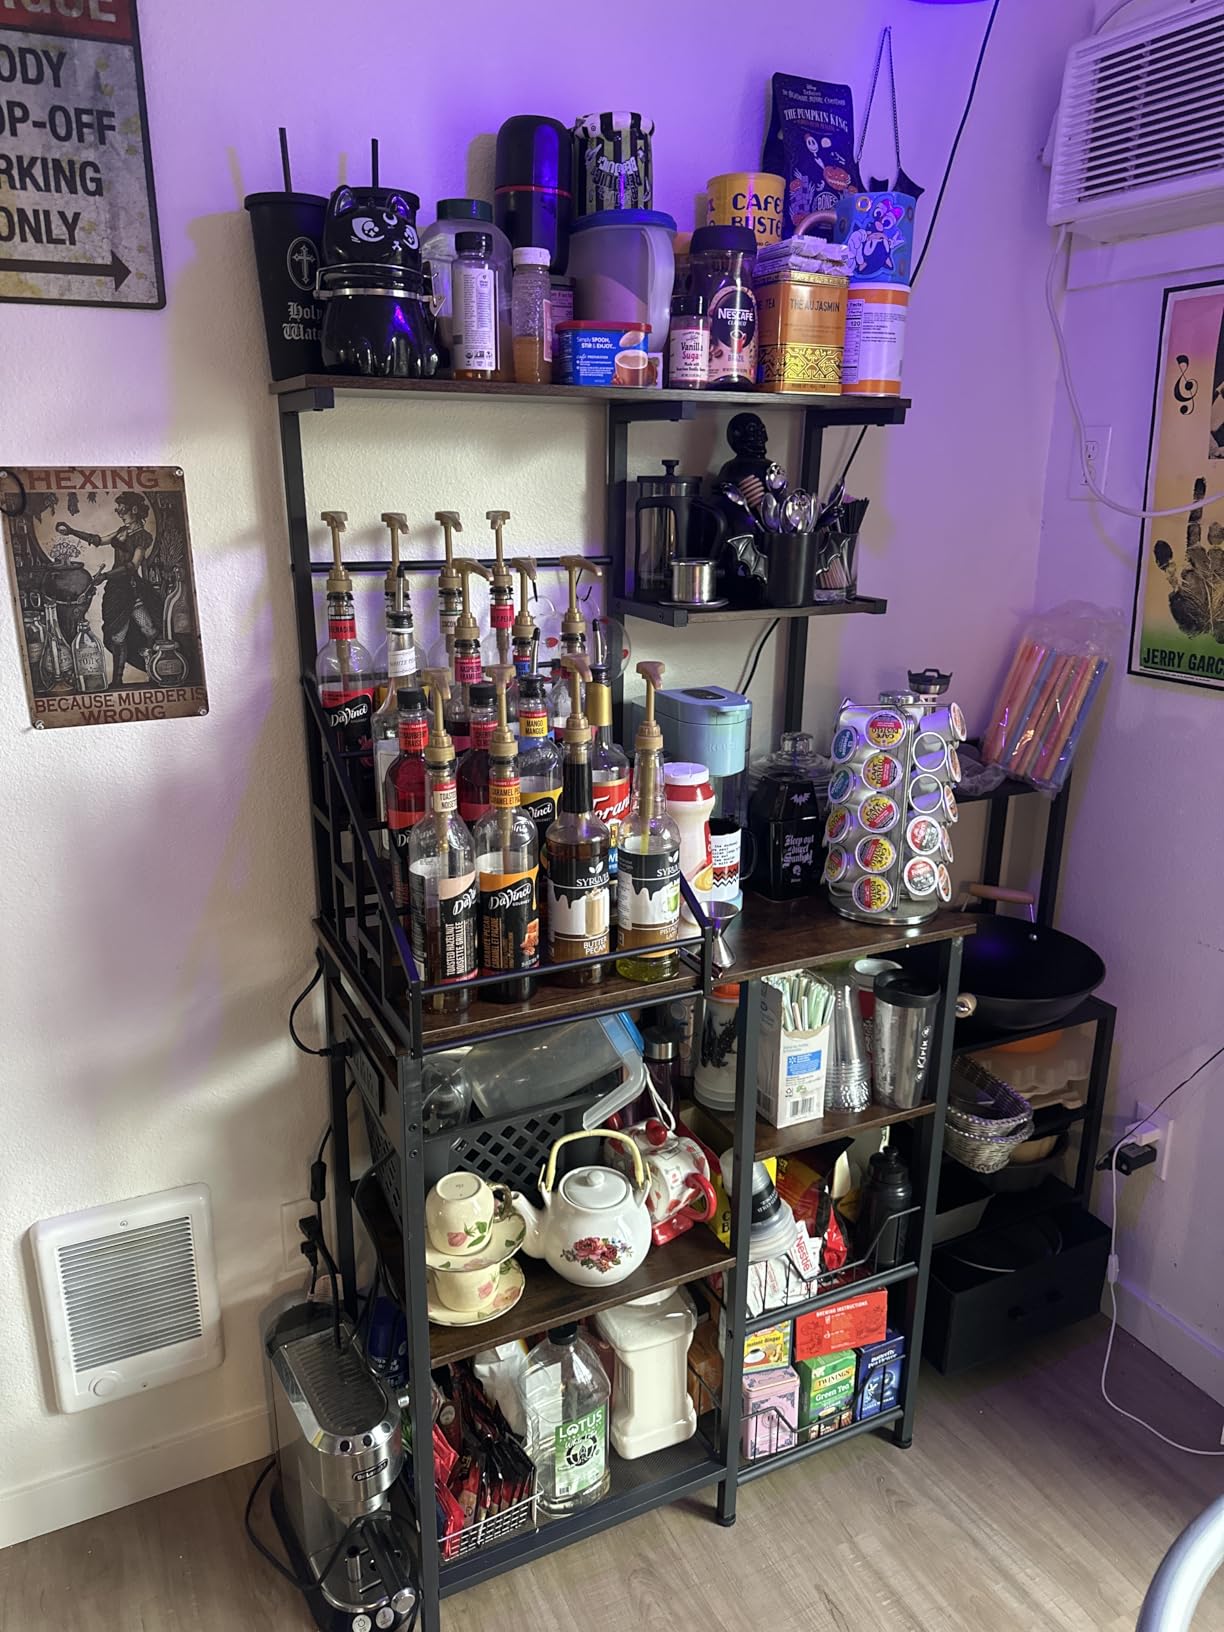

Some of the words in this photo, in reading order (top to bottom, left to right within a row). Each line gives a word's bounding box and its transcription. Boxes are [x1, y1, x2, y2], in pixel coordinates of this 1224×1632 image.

[797, 108, 829, 123] PUMPKIN
[830, 113, 848, 133] KING
[804, 300, 814, 312] AU
[815, 301, 840, 313] JASMIN
[28, 469, 159, 490] HEXING
[1143, 647, 1184, 669] JERRY
[34, 694, 112, 714] BECAUSE
[117, 690, 187, 706] MURDER
[191, 687, 207, 703] IS
[81, 704, 166, 723] WRONG
[330, 703, 368, 728] DaVinci
[526, 719, 544, 728] MANGO
[525, 726, 544, 735] MANGUE
[488, 883, 532, 910] DaVinci
[445, 923, 455, 951] HAZELNUT
[446, 951, 455, 976] TOASTED
[455, 945, 464, 974] NOISETTE
[816, 1308, 836, 1318] BREWING
[836, 1300, 869, 1313] INSTRUCTIONS
[817, 1370, 851, 1387] TWININGS
[815, 1389, 837, 1402] Green
[837, 1383, 850, 1394] Tea
[559, 1410, 602, 1439] LOTUS
